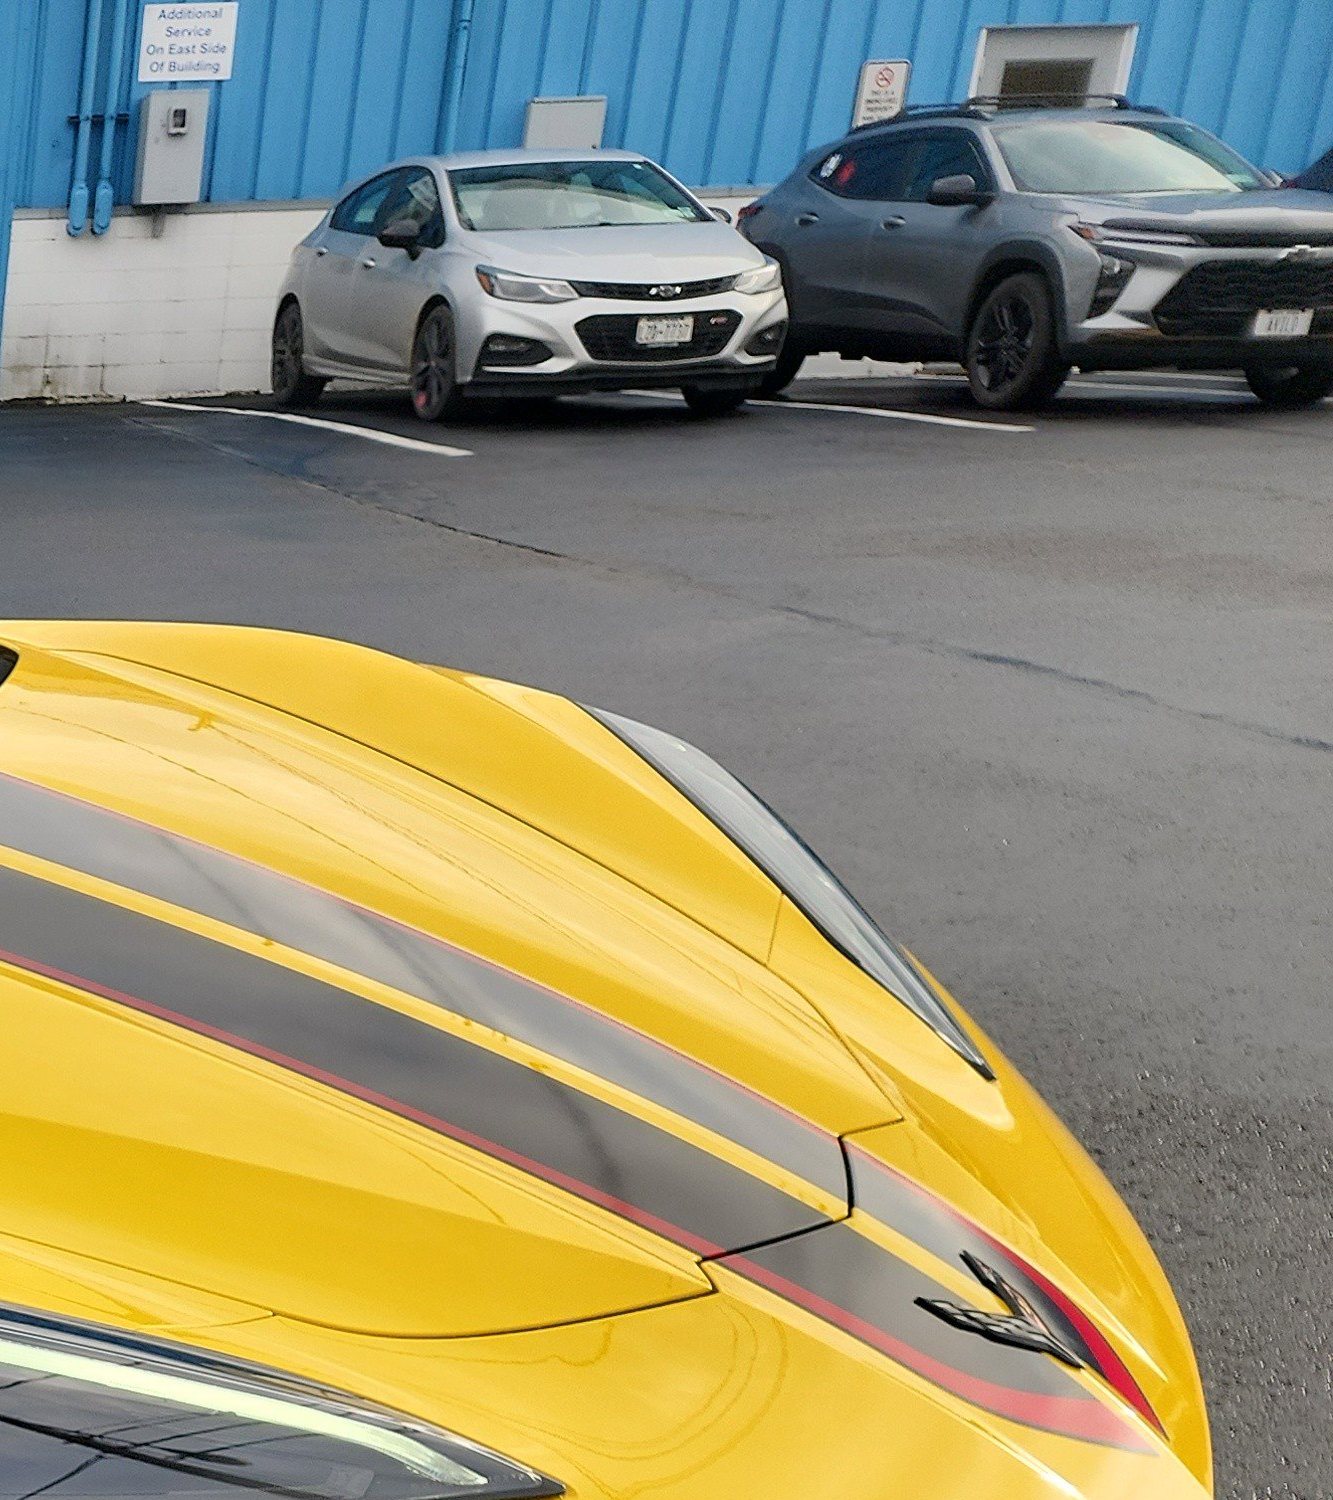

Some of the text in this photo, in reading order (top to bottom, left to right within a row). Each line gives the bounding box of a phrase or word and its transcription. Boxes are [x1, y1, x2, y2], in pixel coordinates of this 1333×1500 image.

[158, 7, 222, 20] Additional
[165, 25, 212, 38] Service
[146, 42, 227, 56] On East Side
[149, 60, 221, 74] Of Building
